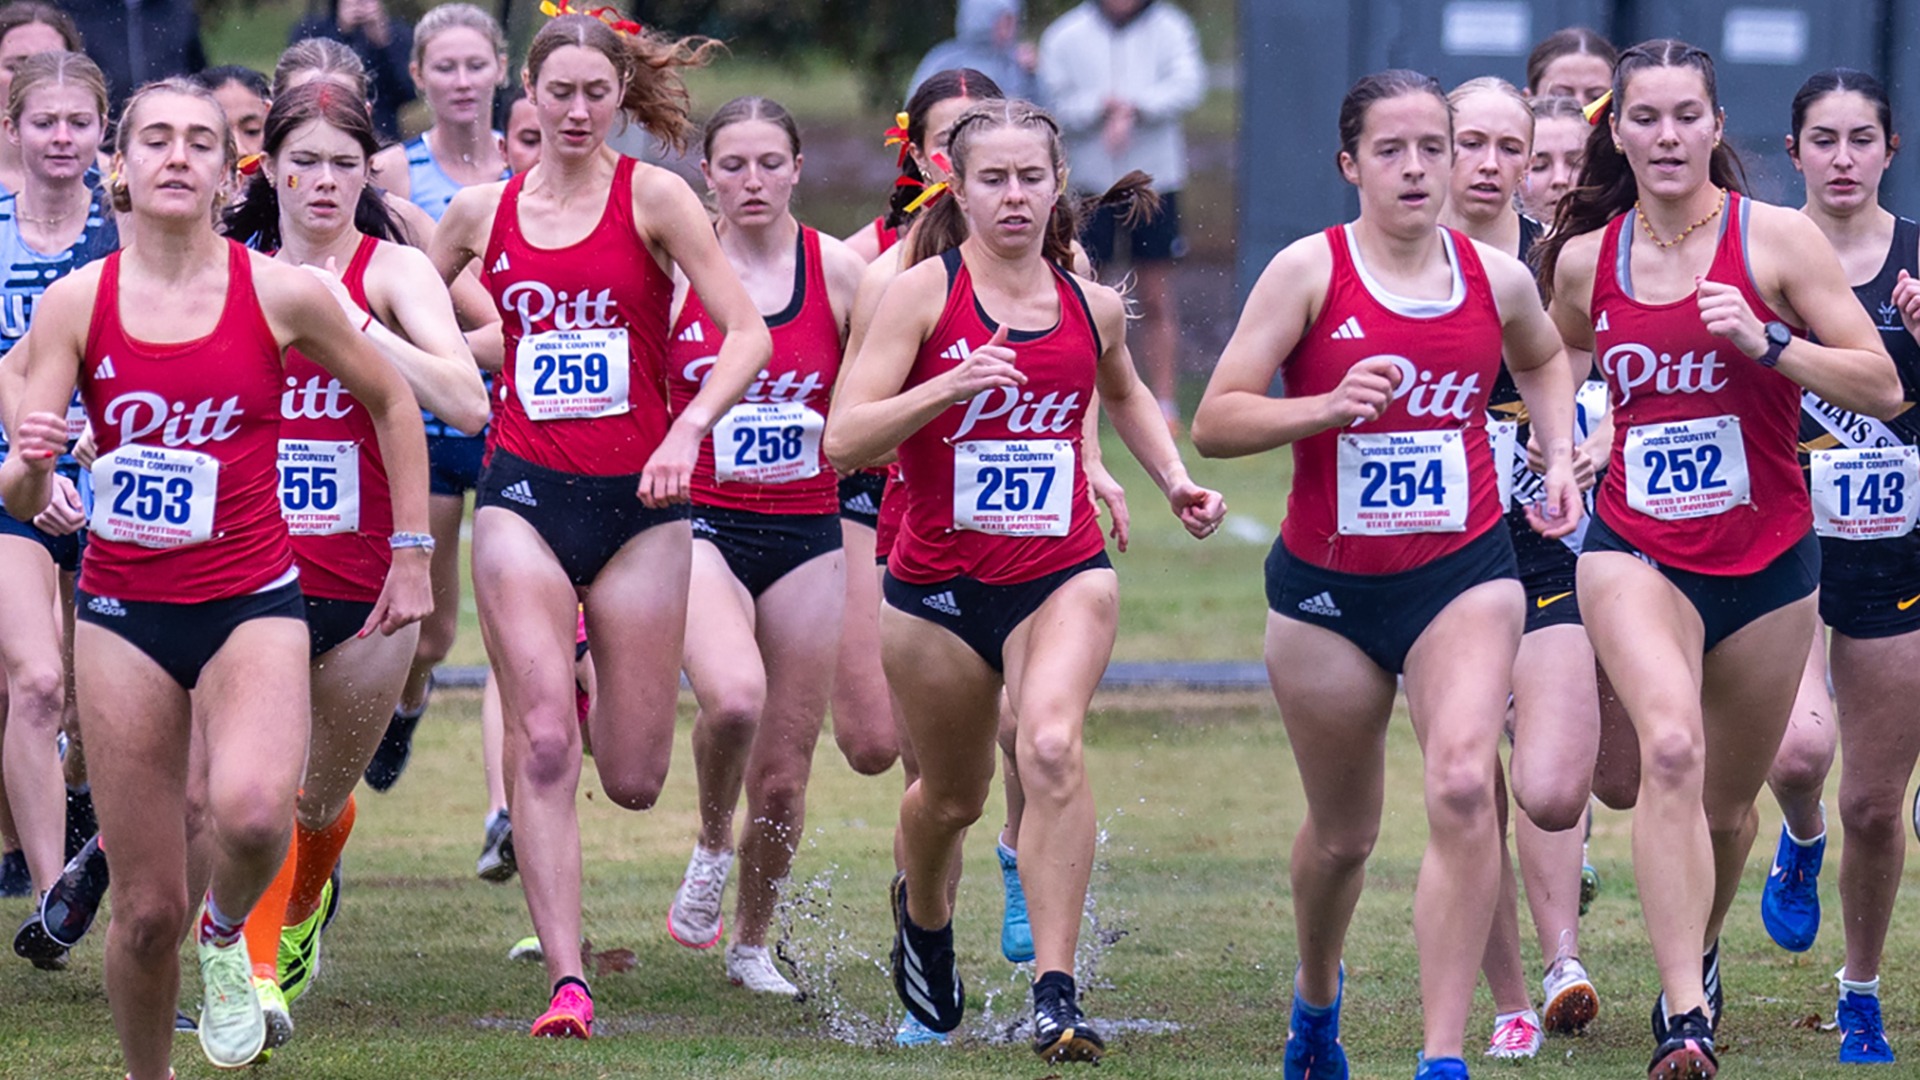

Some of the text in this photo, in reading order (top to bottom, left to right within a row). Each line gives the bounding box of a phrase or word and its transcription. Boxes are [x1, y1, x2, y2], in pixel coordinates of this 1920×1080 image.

[502, 280, 618, 335] Pitt
[533, 352, 608, 396] 259
[1602, 342, 1729, 406] Pitt
[104, 390, 245, 447] Pitt
[950, 385, 1080, 441] Pitt
[1642, 431, 1717, 446] CROSS COUNTRY
[1664, 425, 1689, 435] MIAA
[285, 443, 309, 452] MIAA
[733, 425, 804, 466] 258
[1005, 444, 1029, 452] MIAA
[1390, 436, 1415, 445] MIAA
[292, 453, 336, 462] COUNTRY
[979, 453, 1054, 462] CROSS COUNTRY
[1361, 445, 1442, 456] CROSS COUNTRY
[1643, 444, 1727, 495] 252
[277, 466, 337, 511] 55
[976, 466, 1056, 511] 257
[1360, 459, 1446, 508] 254
[112, 470, 193, 525] 253
[501, 489, 537, 507] adidas
[1645, 489, 1733, 506] HOSTED BY PITTSBURG
[1833, 471, 1905, 516] 143
[1357, 509, 1451, 520] HOSTED BY PITTSBURG
[1654, 506, 1677, 514] STATE
[1680, 500, 1726, 512] UNIVERSITY
[973, 514, 1003, 522] HOSTED
[1005, 514, 1015, 522] BY
[1394, 519, 1442, 528] UNIVERSITY
[87, 601, 127, 617] adidas
[922, 597, 961, 616] adidas
[1298, 601, 1342, 617] adidas
